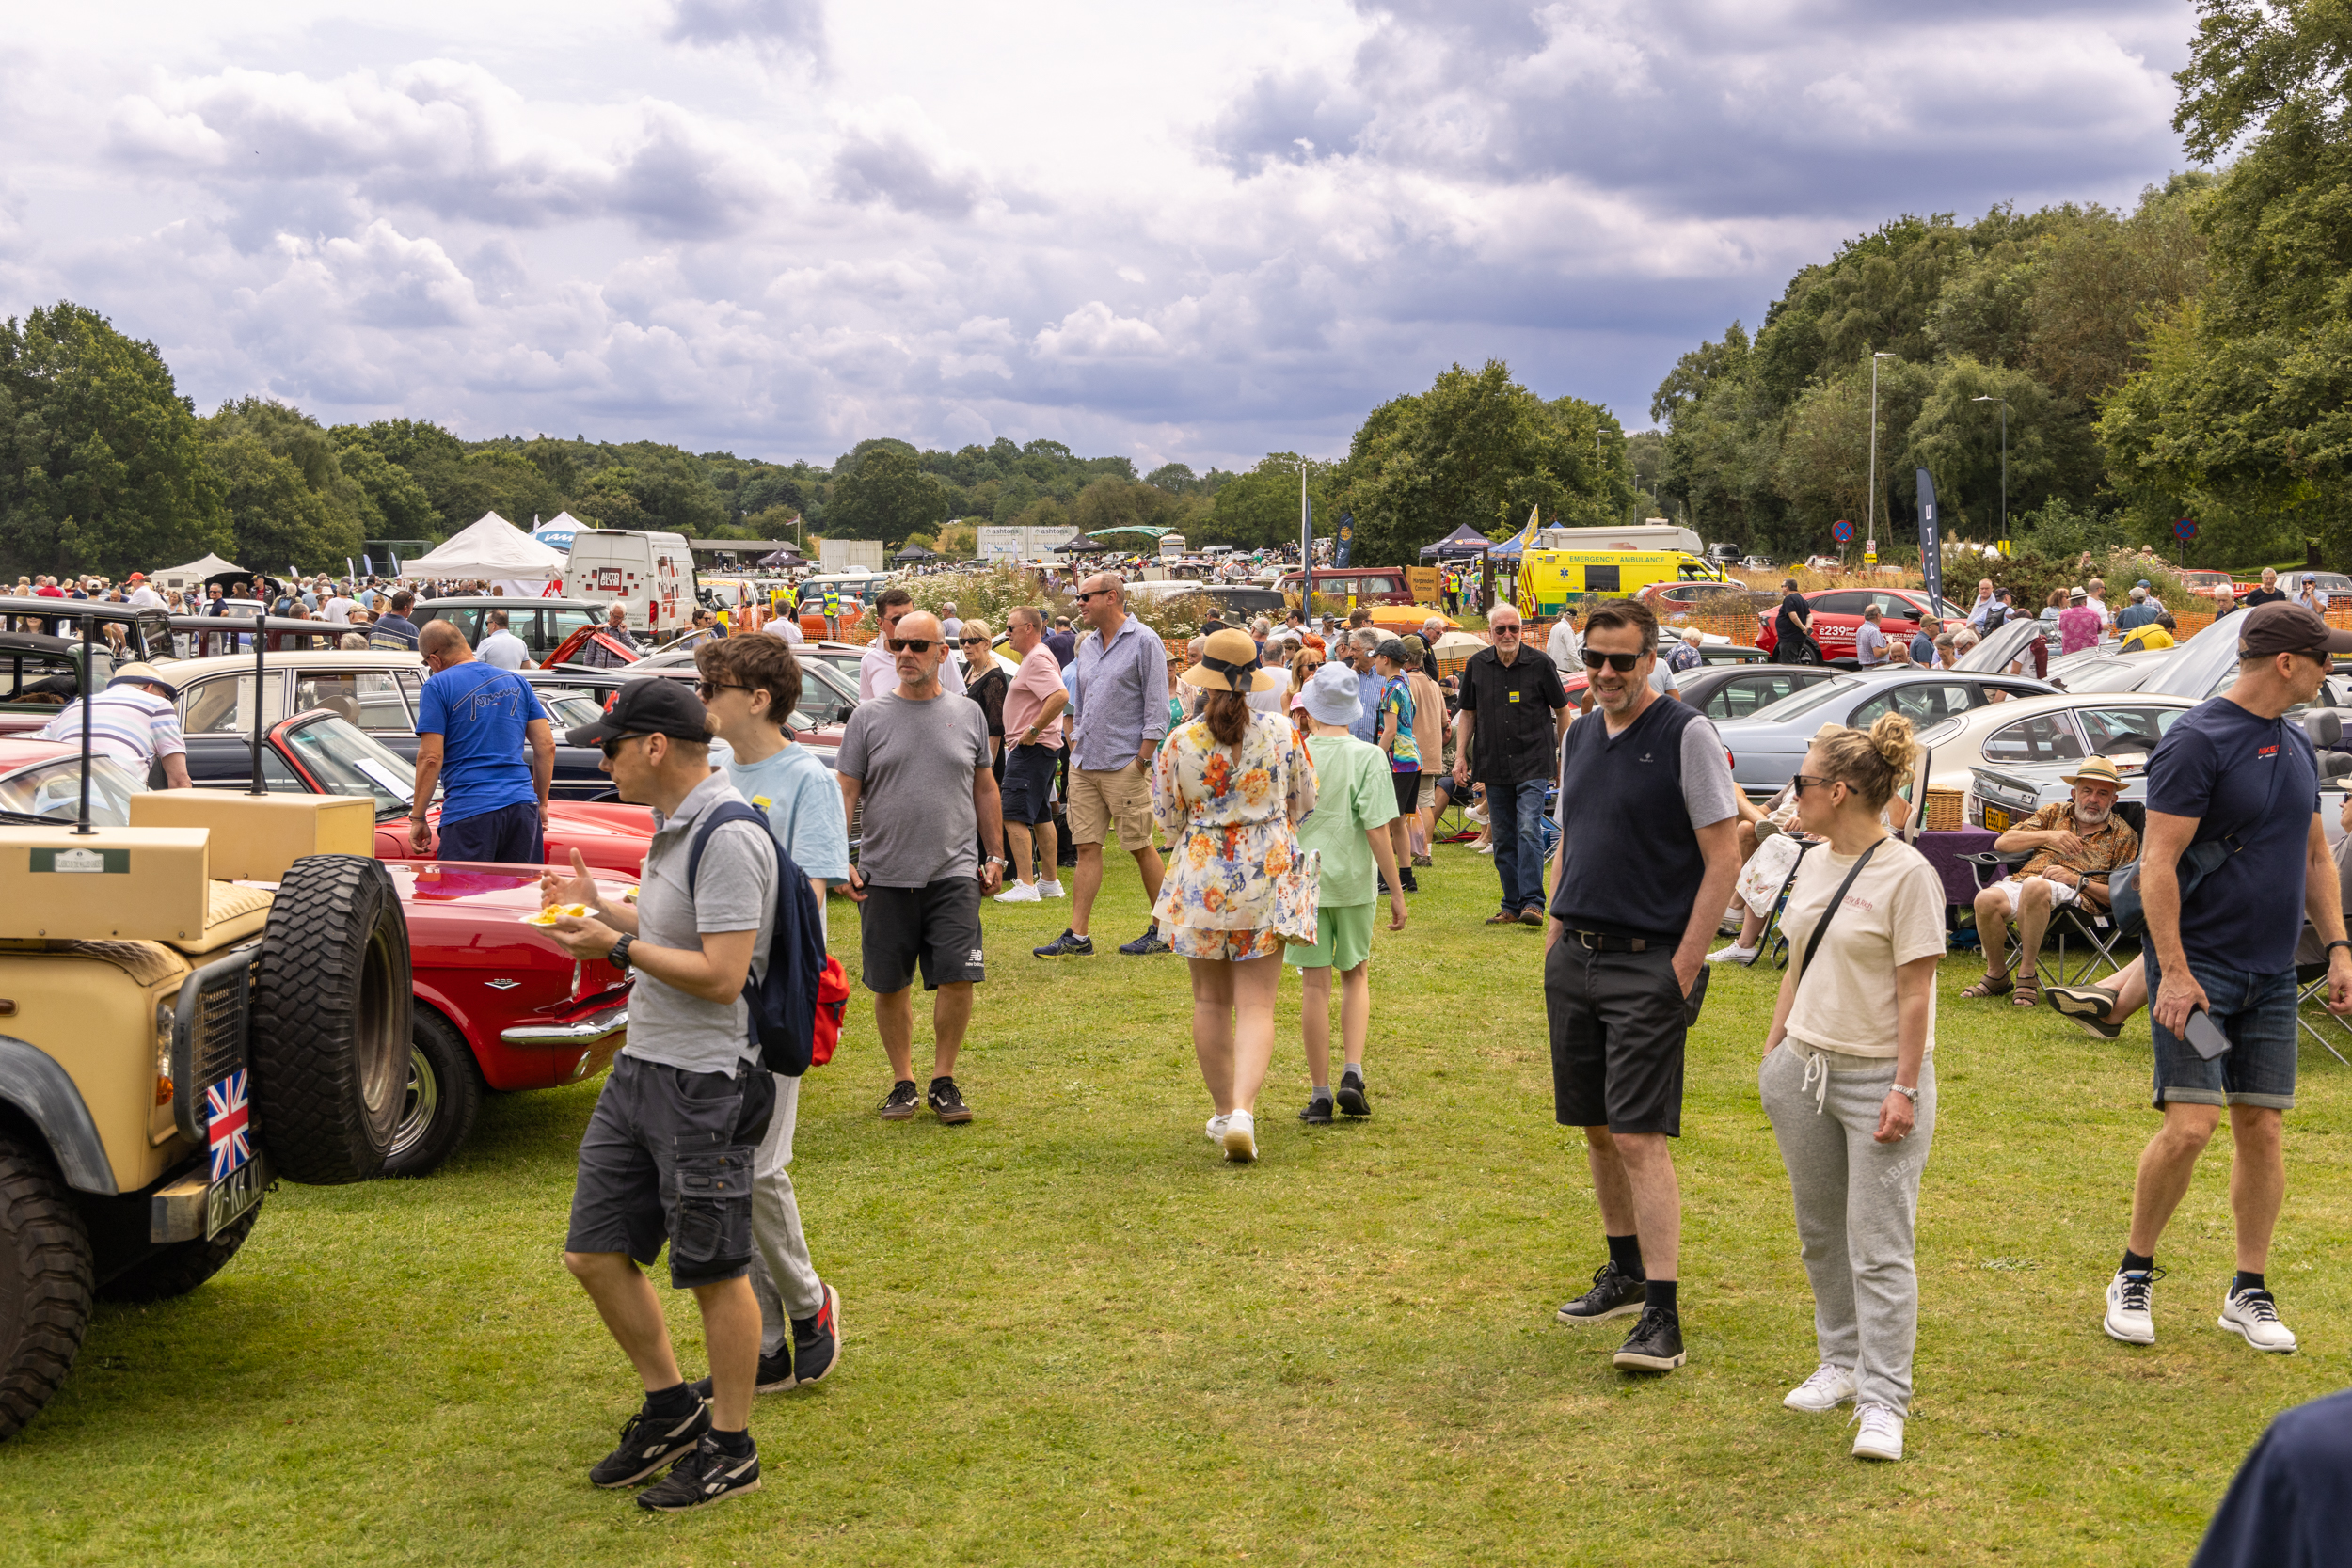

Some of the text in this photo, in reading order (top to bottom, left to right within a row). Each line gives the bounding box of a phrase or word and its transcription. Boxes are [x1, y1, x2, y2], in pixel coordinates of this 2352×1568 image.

[600, 578, 620, 586] GLYM
[1820, 626, 1846, 636] £239
[2258, 745, 2277, 754] NIKE
[1861, 899, 1872, 910] Rich
[211, 1180, 225, 1231] 27
[230, 1167, 248, 1215] KK
